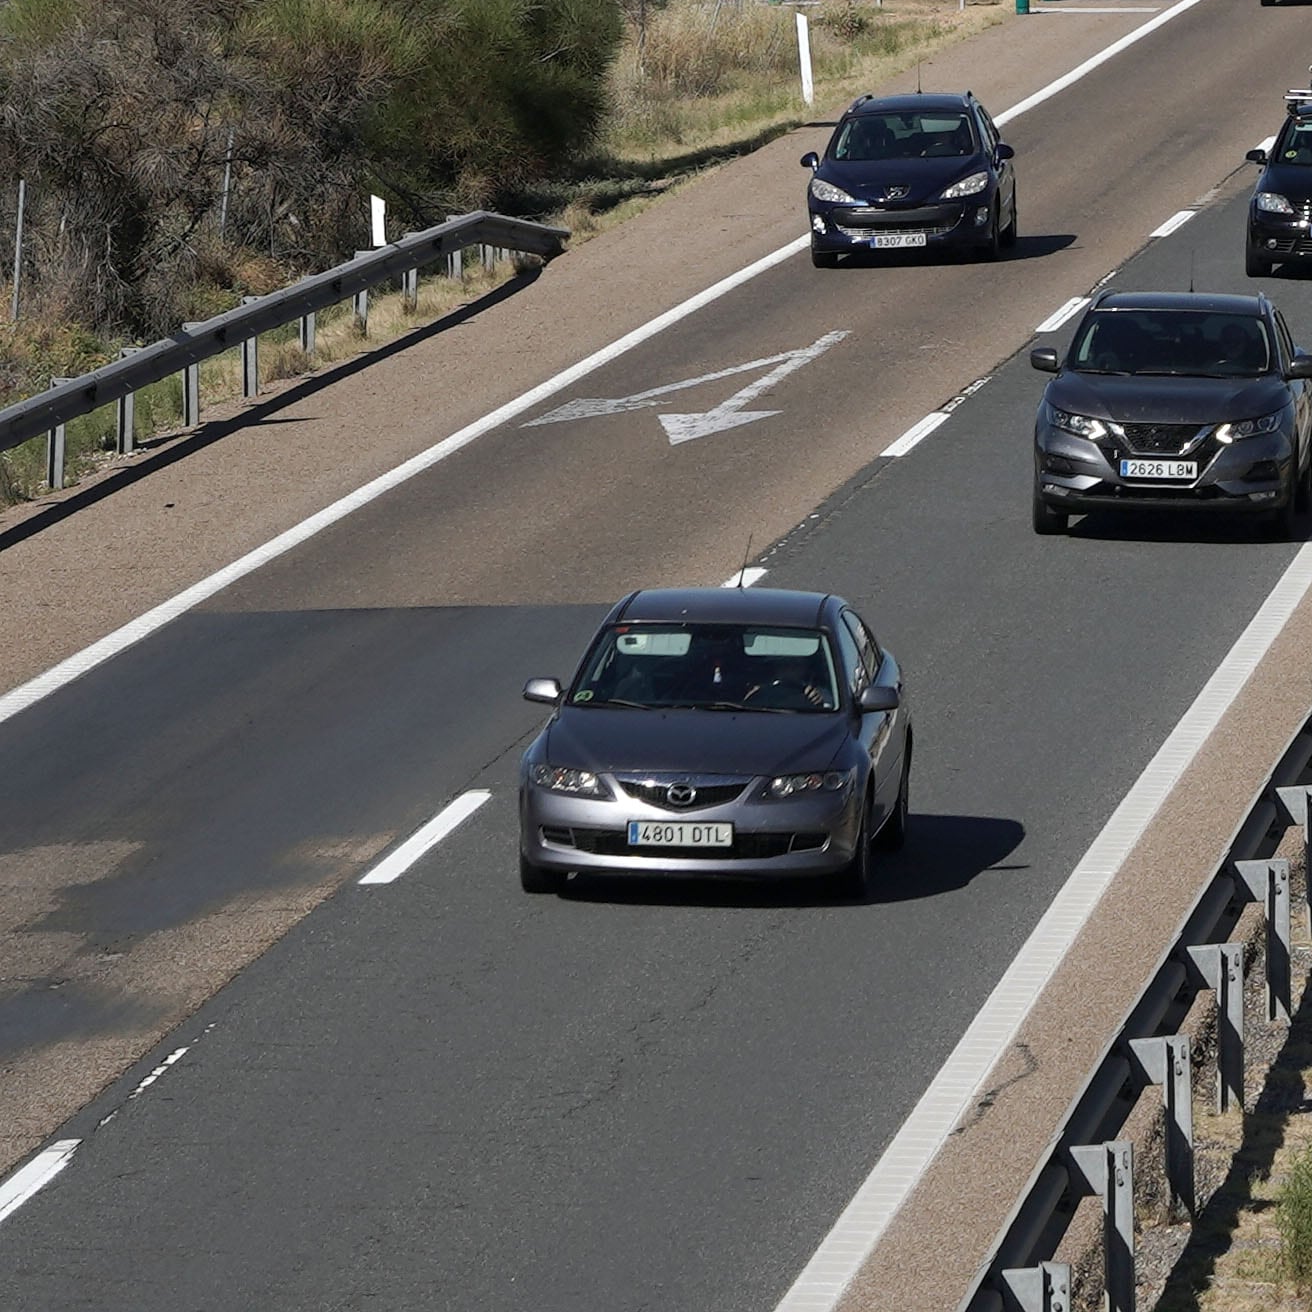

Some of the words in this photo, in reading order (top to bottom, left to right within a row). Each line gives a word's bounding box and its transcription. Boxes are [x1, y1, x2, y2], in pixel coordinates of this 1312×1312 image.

[1130, 463, 1164, 476] 2626
[642, 825, 683, 843] 4801
[692, 826, 725, 843] DTL
